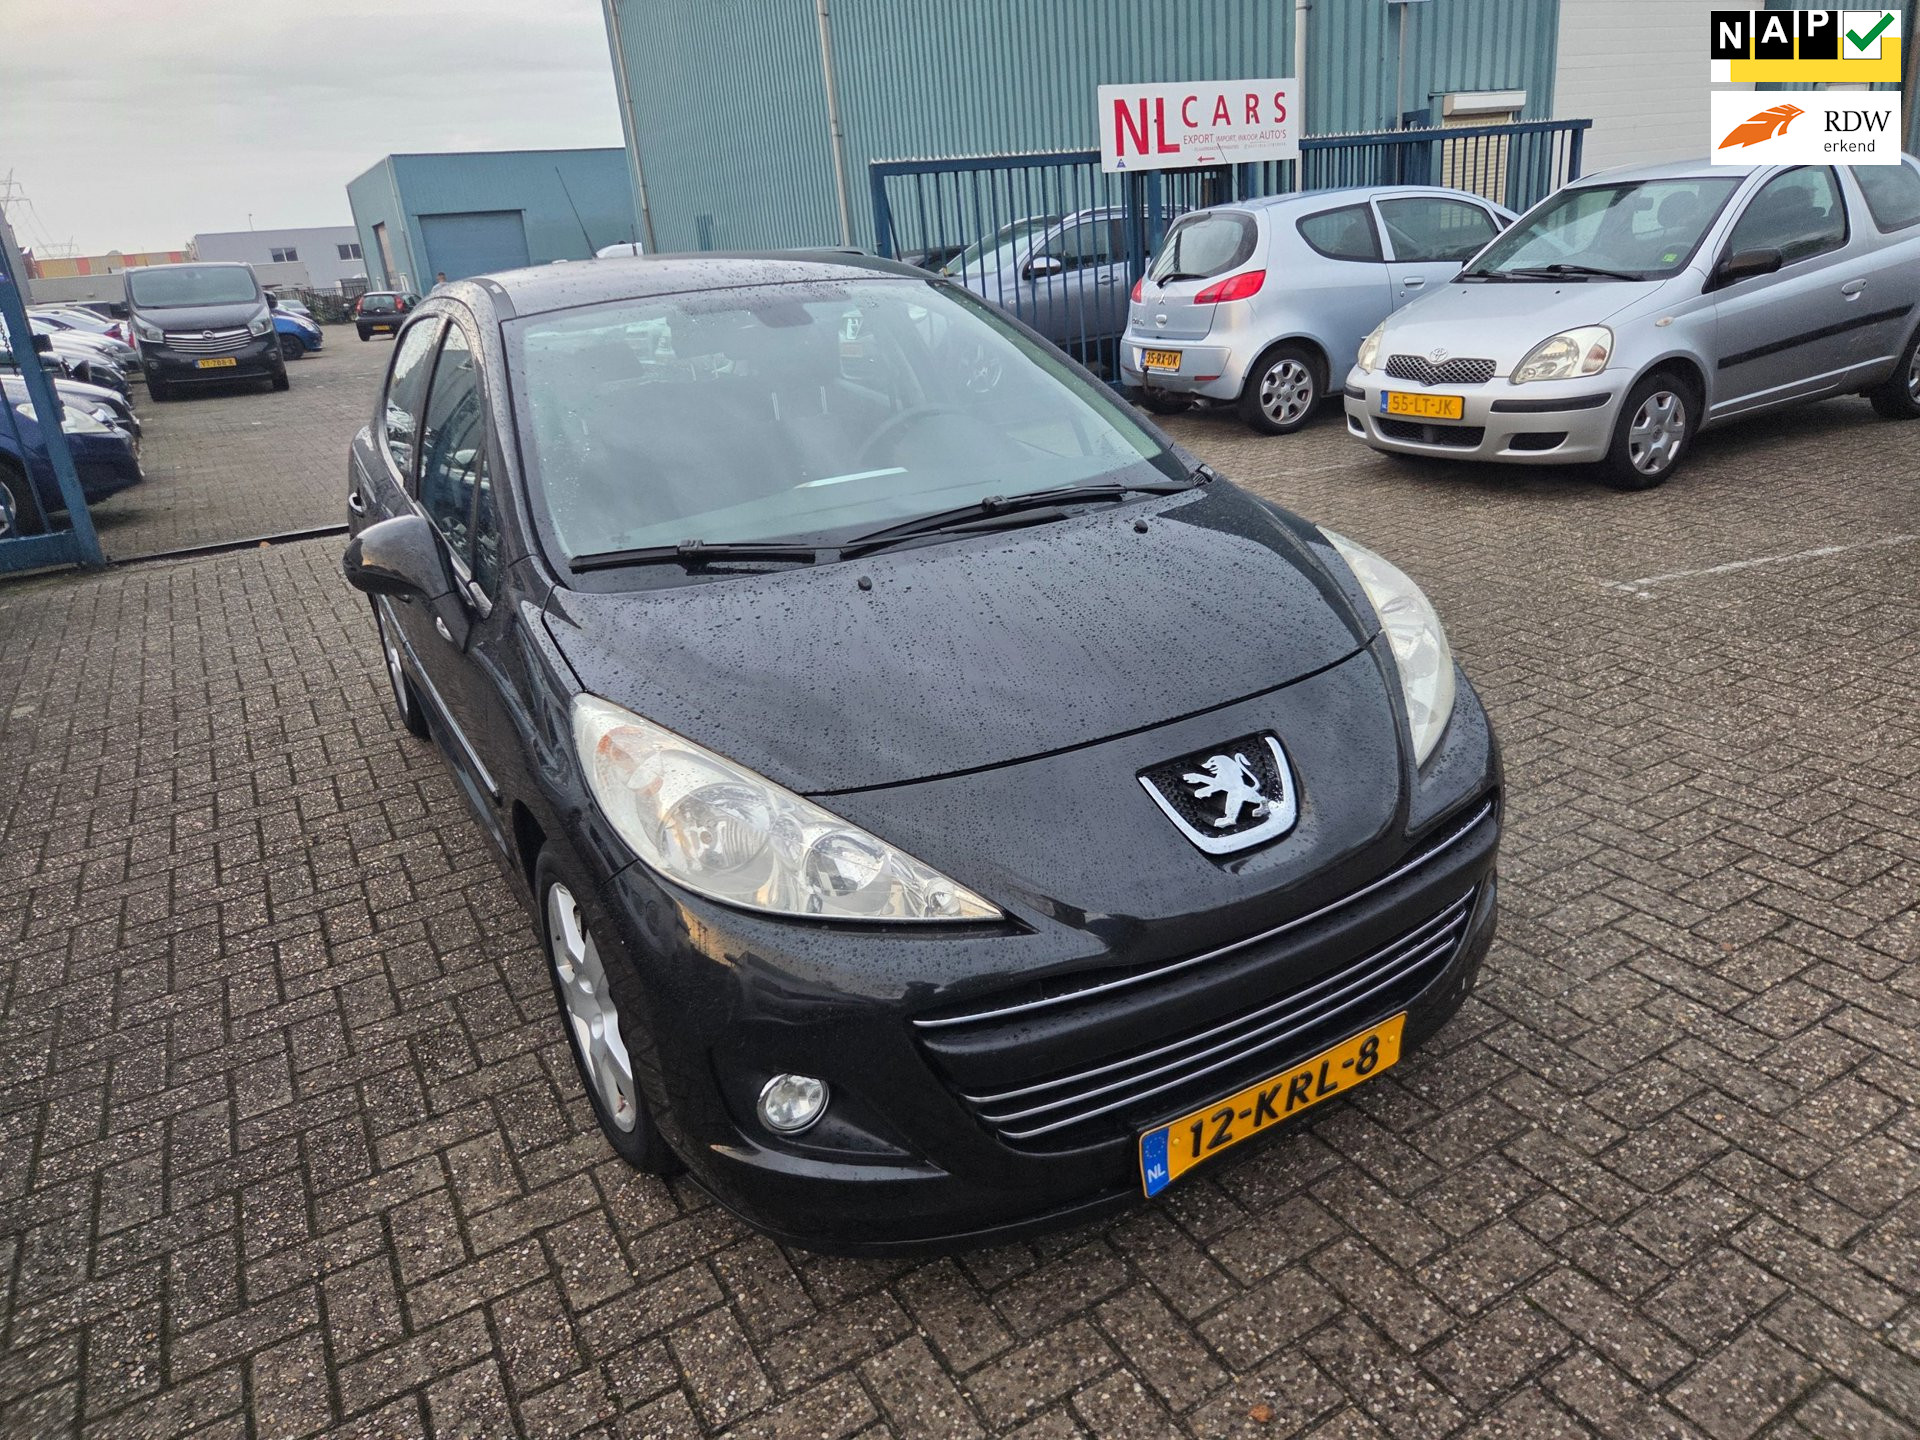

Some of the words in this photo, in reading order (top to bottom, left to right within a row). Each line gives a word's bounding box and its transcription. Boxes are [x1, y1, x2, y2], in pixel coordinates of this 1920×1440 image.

[1114, 97, 1181, 157] NL
[1181, 92, 1287, 128] CARS
[1259, 129, 1287, 140] AUTO'S
[1146, 351, 1178, 367] 35-RX-DK
[1392, 395, 1453, 415] 55-LT-JK
[1189, 1034, 1380, 1158] 12-KRL-8
[1147, 1163, 1166, 1183] NL
